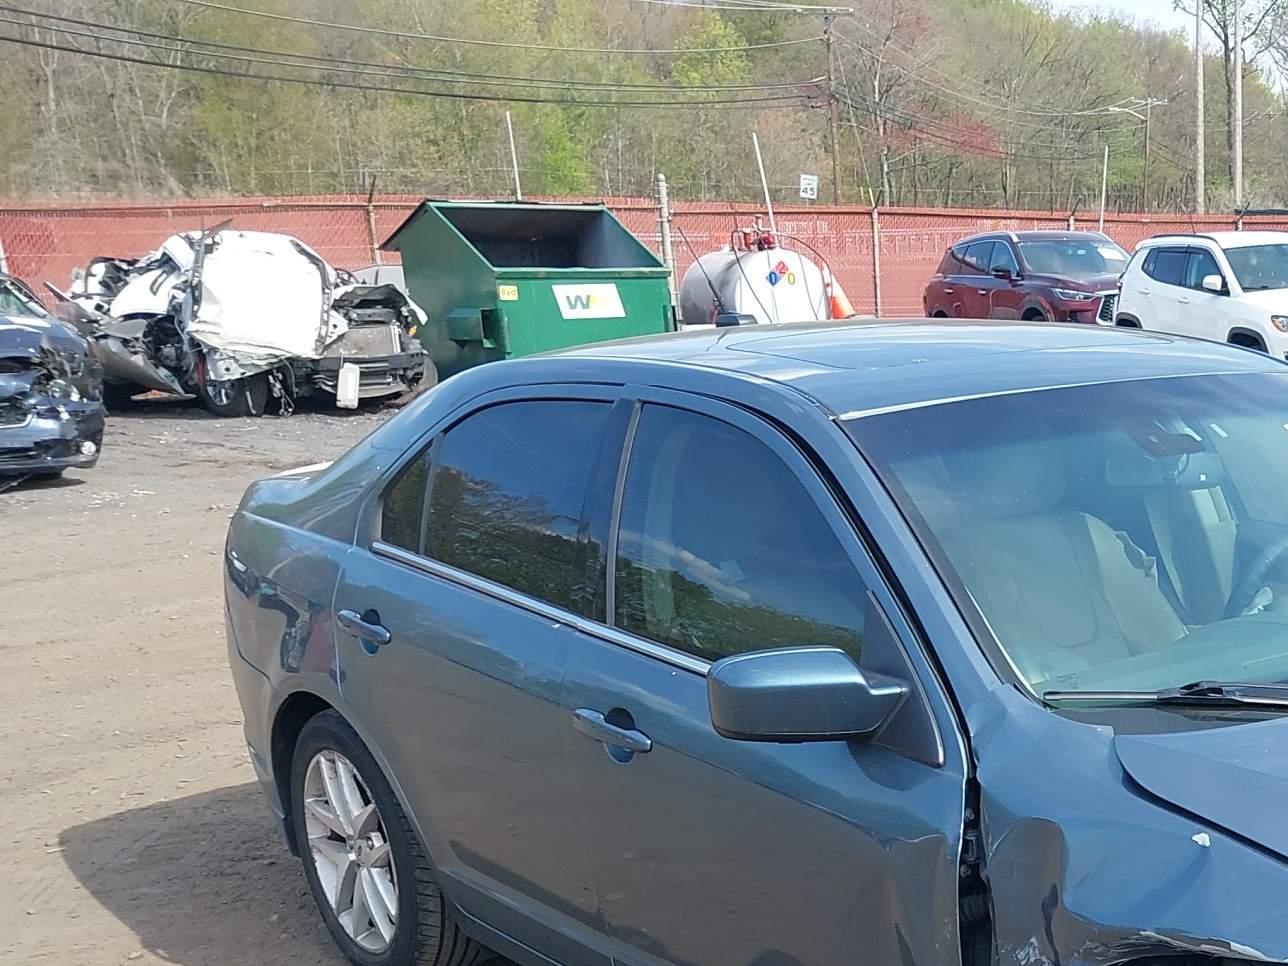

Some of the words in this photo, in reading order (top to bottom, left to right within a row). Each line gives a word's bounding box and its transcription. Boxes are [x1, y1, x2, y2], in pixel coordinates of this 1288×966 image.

[802, 187, 816, 196] 45
[775, 261, 786, 274] 2
[788, 272, 796, 286] 0
